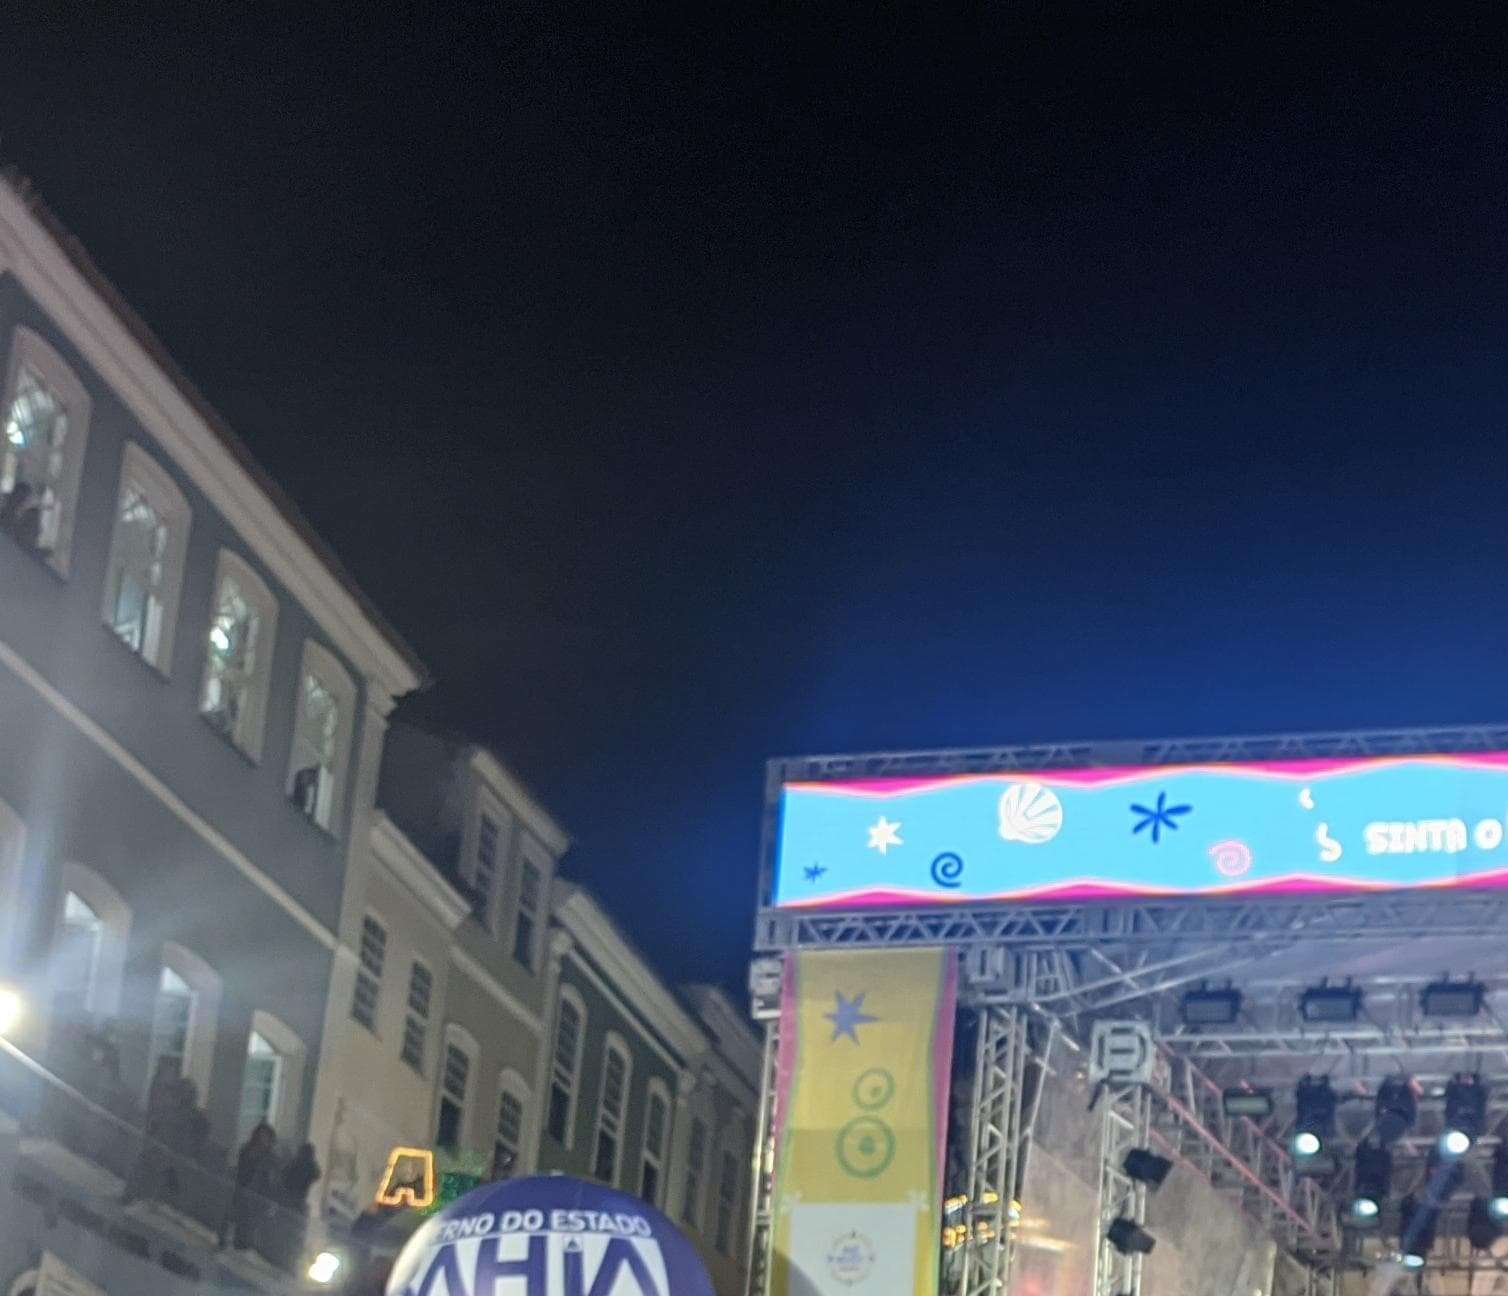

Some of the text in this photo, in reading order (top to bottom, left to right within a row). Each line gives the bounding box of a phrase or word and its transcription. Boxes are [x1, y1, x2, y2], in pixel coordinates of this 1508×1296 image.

[1364, 817, 1468, 854] SINTA
[1475, 818, 1502, 850] O
[501, 1209, 544, 1232] DO
[551, 1208, 653, 1237] ESTADO
